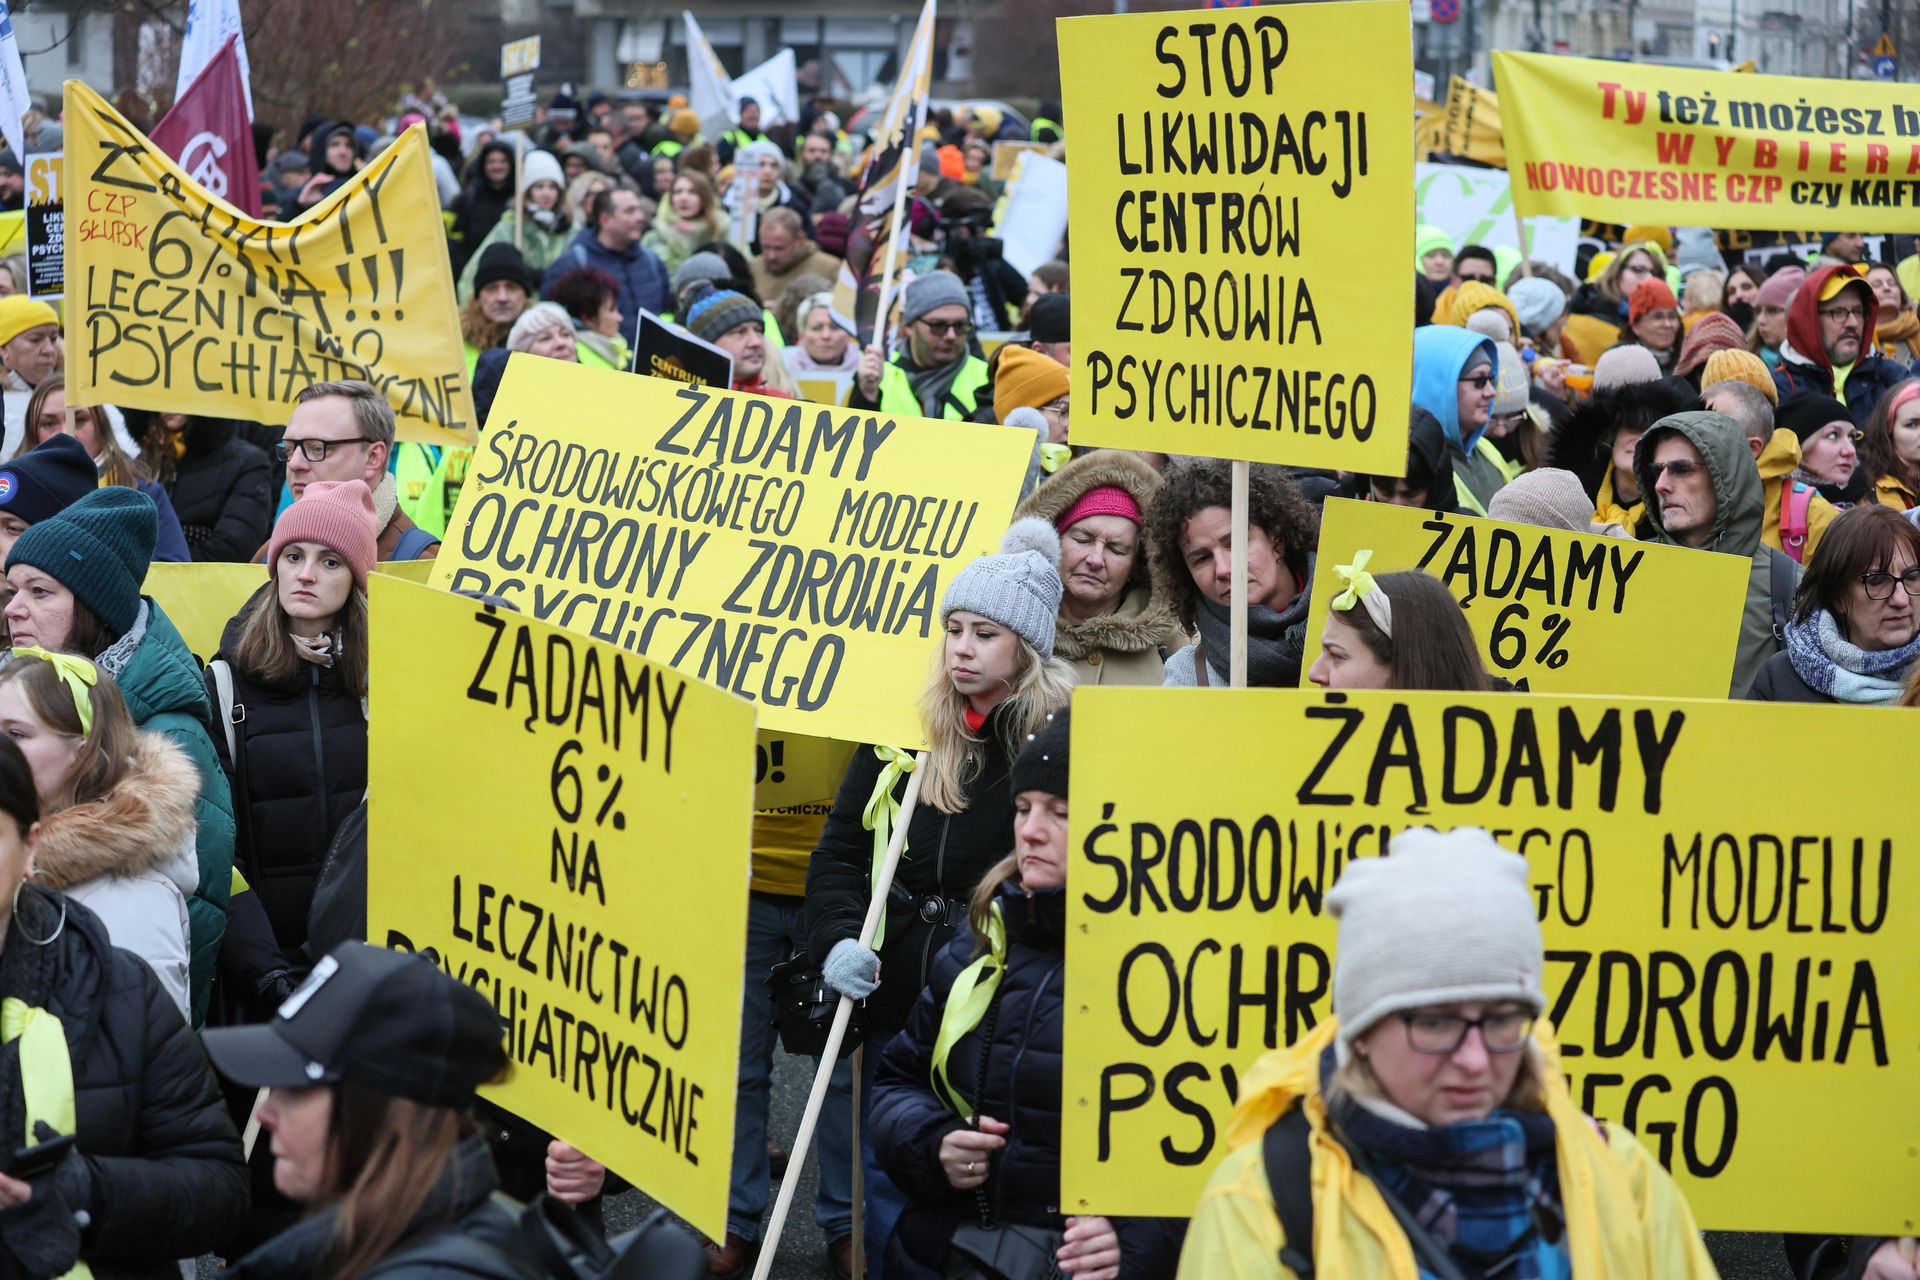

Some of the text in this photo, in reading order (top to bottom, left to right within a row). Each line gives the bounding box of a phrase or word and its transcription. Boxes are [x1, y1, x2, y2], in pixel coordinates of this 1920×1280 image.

[1155, 15, 1289, 98] STOP
[1597, 81, 1920, 137] Ty też możesz b
[1117, 110, 1368, 198] LIKWIDACJI
[1525, 161, 1718, 202] NOWOCZESNE
[1726, 173, 1783, 204] CZP
[1791, 181, 1843, 208] czy
[43, 212, 64, 224] LIK
[48, 233, 64, 244] ZD
[79, 218, 149, 251] SŁUPSK
[87, 188, 138, 216] CZP
[1115, 182, 1300, 257] CENTRÓW
[87, 265, 383, 367] LECZNICTWO
[1115, 267, 1321, 345] ZDROWIA
[650, 354, 708, 386] CENTRUM
[1086, 350, 1377, 443] PSYCHICZNEGO
[655, 383, 896, 482] ŻĄDAMY
[829, 487, 978, 559] MODELU
[1415, 512, 1645, 615] ŻĄDAMY
[461, 492, 711, 602] OCHRONY
[722, 538, 940, 639] ZDROWiA
[1488, 602, 1572, 670] 6%
[466, 602, 687, 774] ŻĄDAMY
[550, 739, 627, 831] 6%
[1296, 690, 1686, 816] ŻĄDAMY
[550, 825, 607, 906] NA
[1662, 831, 1892, 935] MODELU
[452, 873, 690, 1052] LECZNiCTWO
[1117, 937, 1333, 1049] OCHR
